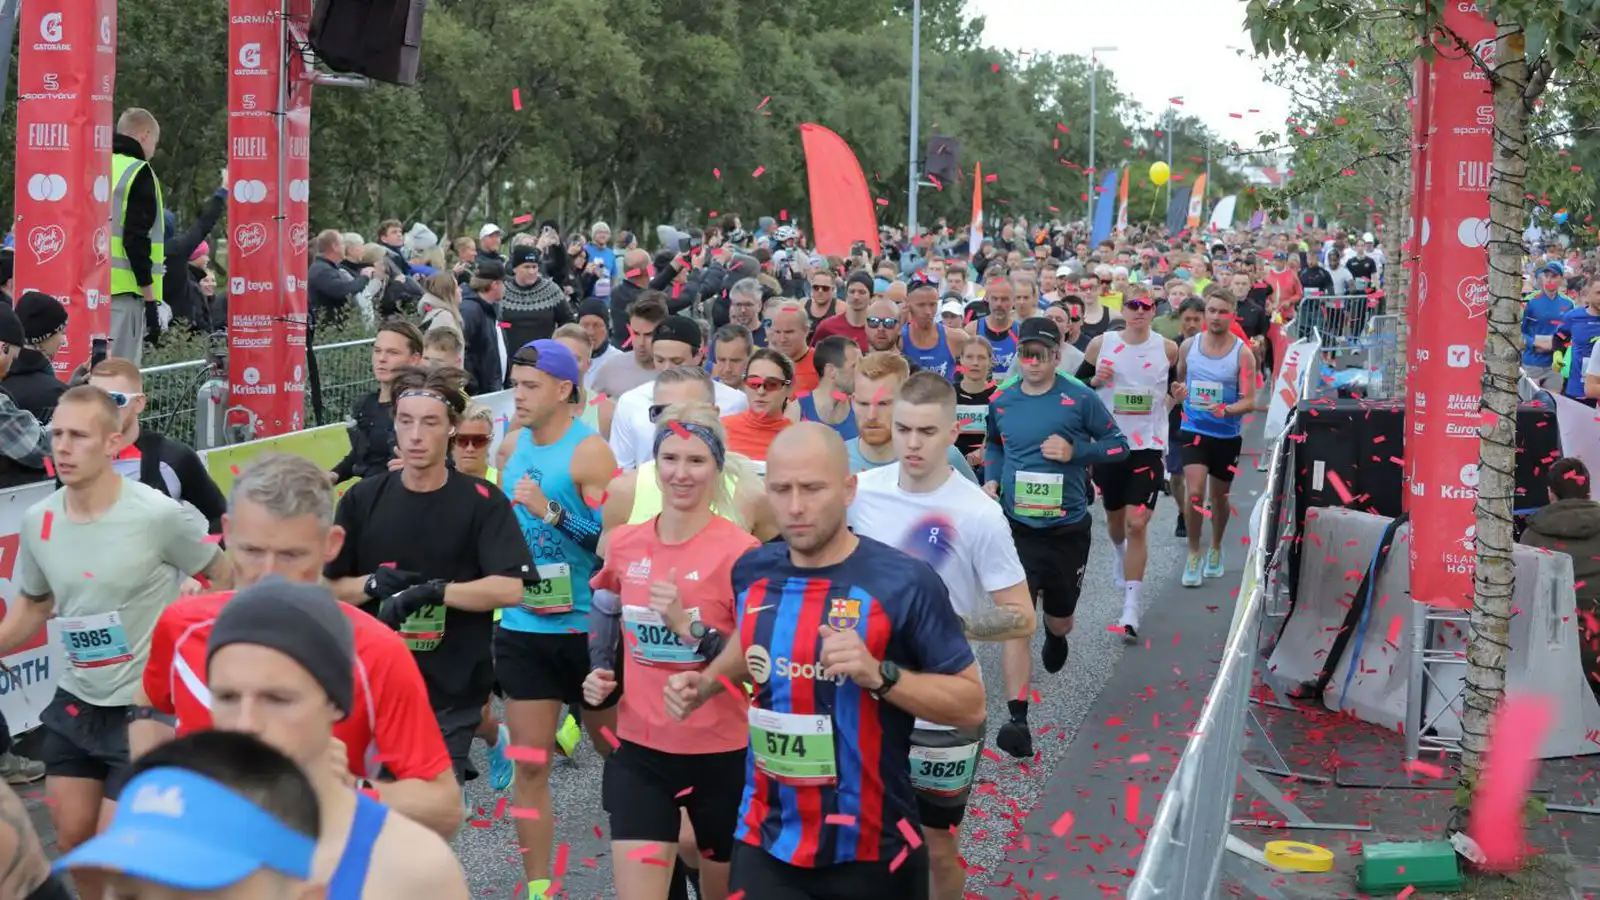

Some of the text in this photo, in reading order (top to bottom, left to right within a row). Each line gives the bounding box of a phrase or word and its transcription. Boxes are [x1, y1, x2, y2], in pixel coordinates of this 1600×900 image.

[232, 15, 274, 24] GARMIN
[33, 43, 72, 51] GATORADE
[29, 122, 69, 147] FULFIL
[233, 136, 267, 157] FULFIL
[247, 280, 273, 292] teya
[232, 336, 272, 346] Europcar
[232, 383, 276, 394] Kristall
[1125, 394, 1143, 405] 189
[1026, 482, 1050, 496] 323
[69, 627, 113, 650] 5985
[775, 656, 848, 686] Spoty
[766, 731, 807, 757] 574
[919, 759, 966, 778] 3626
